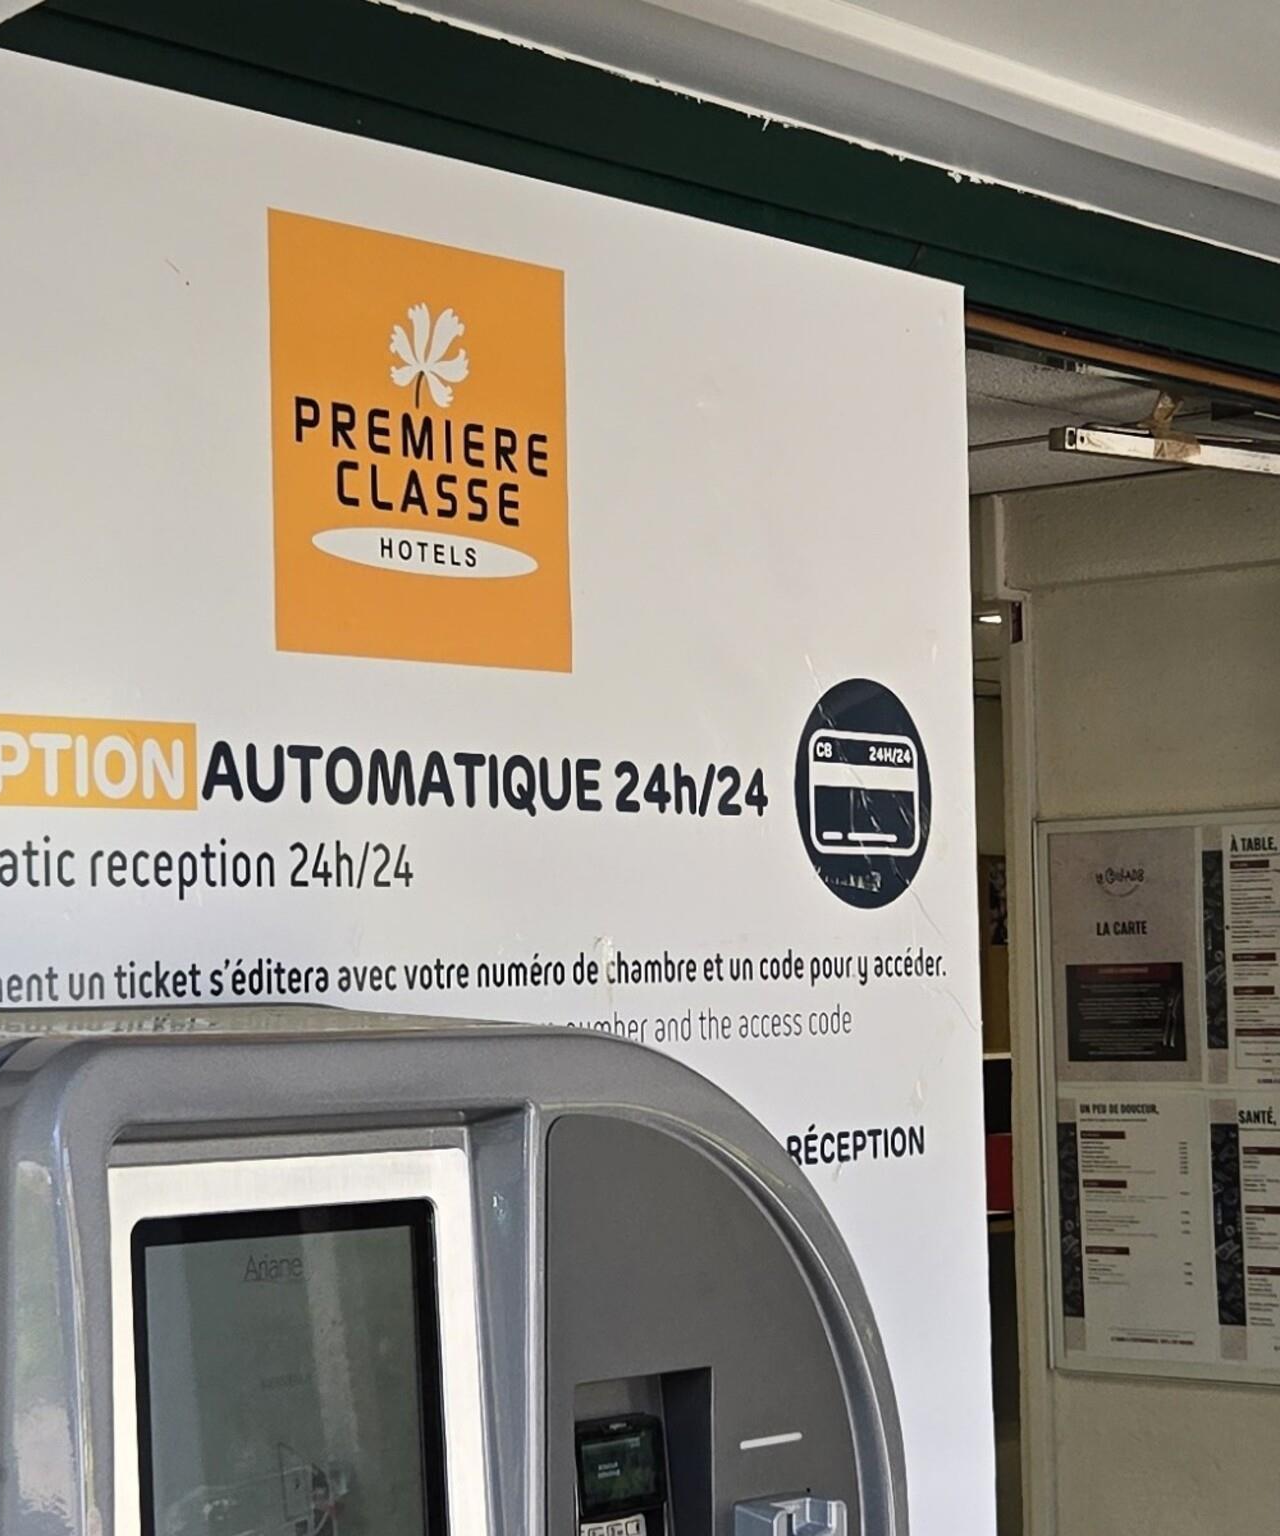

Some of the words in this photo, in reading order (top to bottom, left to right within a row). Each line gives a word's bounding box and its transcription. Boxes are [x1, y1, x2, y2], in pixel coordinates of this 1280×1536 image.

[295, 396, 549, 478] PREMIERE
[336, 460, 520, 527] CLASSE
[380, 537, 478, 568] HOTELS
[868, 745, 912, 766] 24H/24
[202, 740, 602, 817] AUTOMATIQUE
[614, 760, 769, 817] 24h/24
[90, 837, 276, 901] reception
[289, 839, 414, 889] 24h/24
[1096, 921, 1111, 937] LA
[1113, 920, 1148, 936] CARTE
[69, 972, 105, 1002] un
[114, 960, 202, 999] ticket
[337, 964, 397, 993] avec
[404, 958, 469, 991] votre
[477, 952, 565, 988] numéro
[572, 951, 599, 986] de
[606, 950, 697, 985] chambre
[703, 952, 724, 983] et
[729, 957, 754, 981] un
[759, 948, 805, 981] code
[810, 955, 853, 988] pour
[857, 955, 869, 986] y
[873, 946, 947, 977] accéder.
[655, 1008, 692, 1042] and
[699, 1007, 732, 1040] the
[738, 1010, 803, 1039] access
[809, 1003, 853, 1034] code
[786, 1124, 926, 1167] RÉCEPTION
[244, 1253, 304, 1282] Ariane
